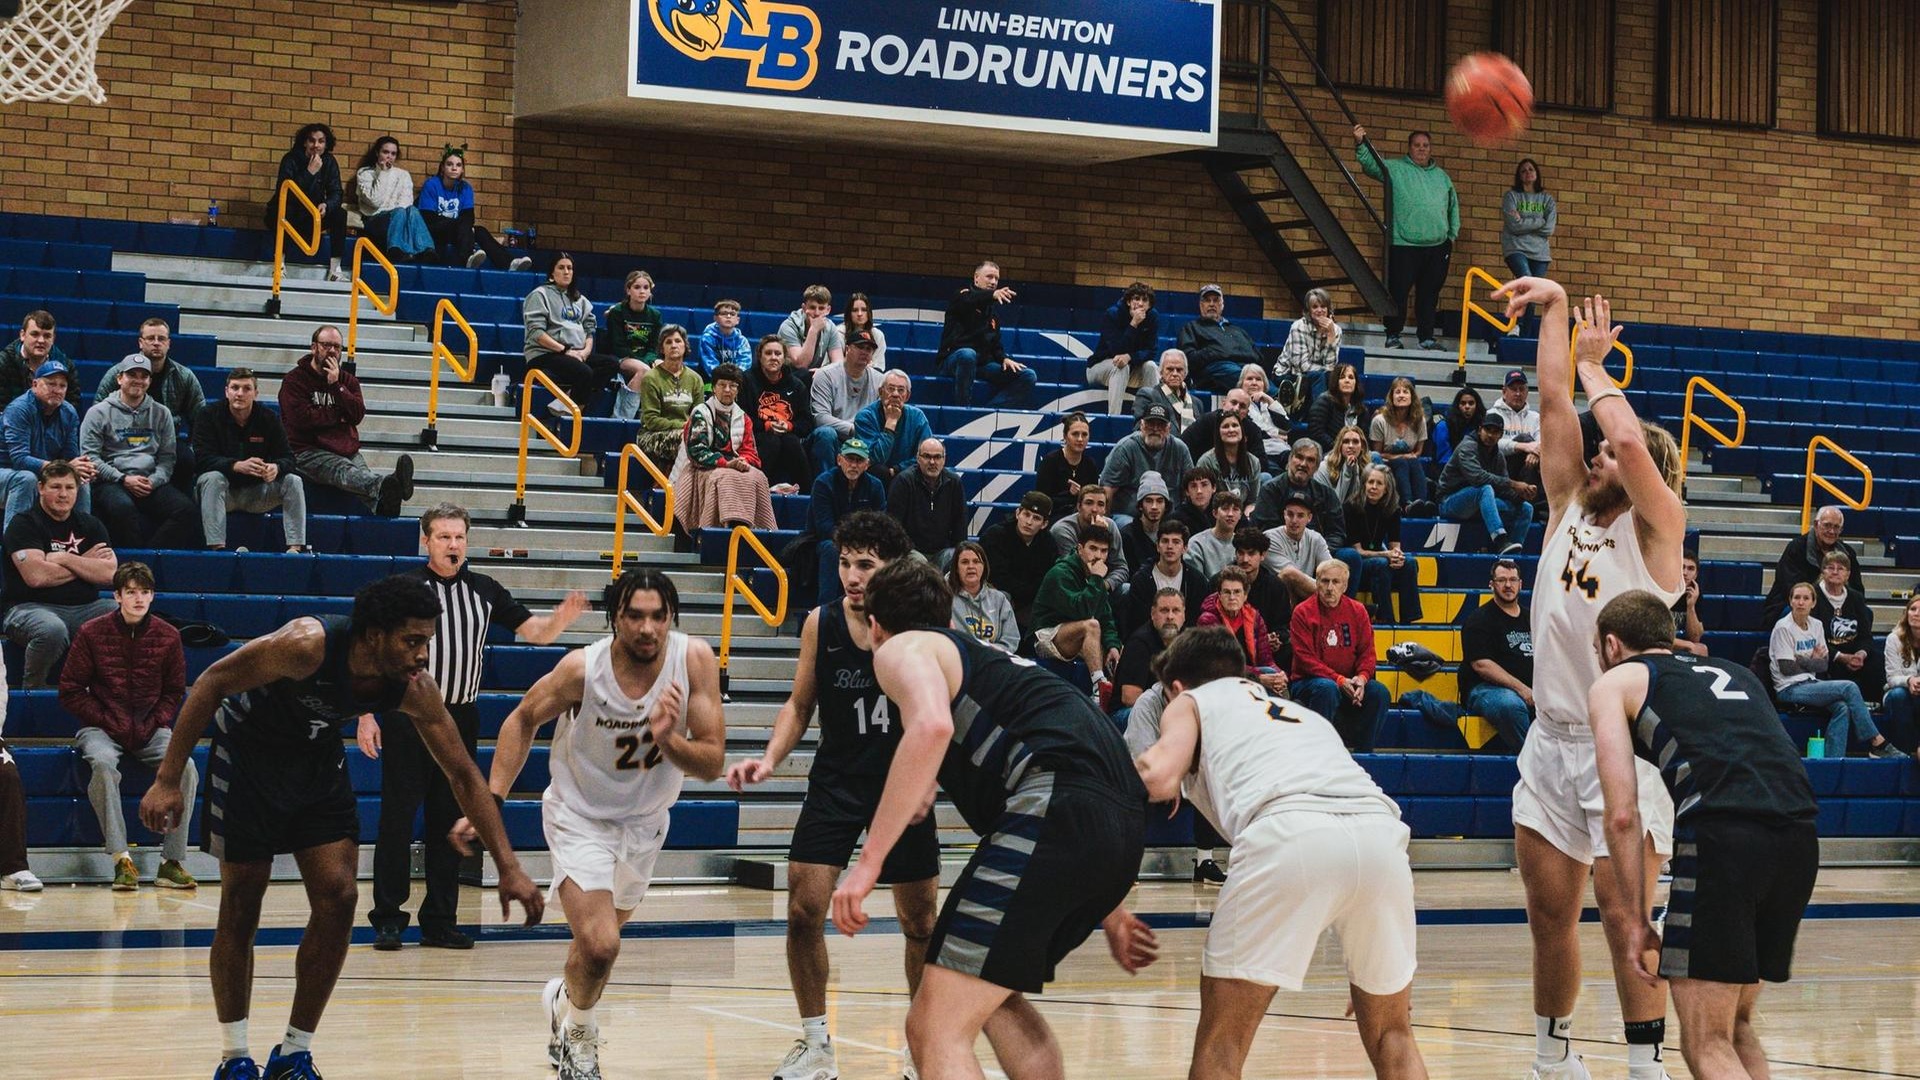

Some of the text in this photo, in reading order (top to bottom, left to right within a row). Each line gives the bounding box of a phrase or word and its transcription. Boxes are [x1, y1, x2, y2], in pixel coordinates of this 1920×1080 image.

[937, 7, 1114, 46] LINN-BENTON
[835, 31, 1206, 102] ROADRUNNERS
[1690, 665, 1750, 700] 2
[853, 694, 890, 734] 14
[615, 731, 664, 770] 22
